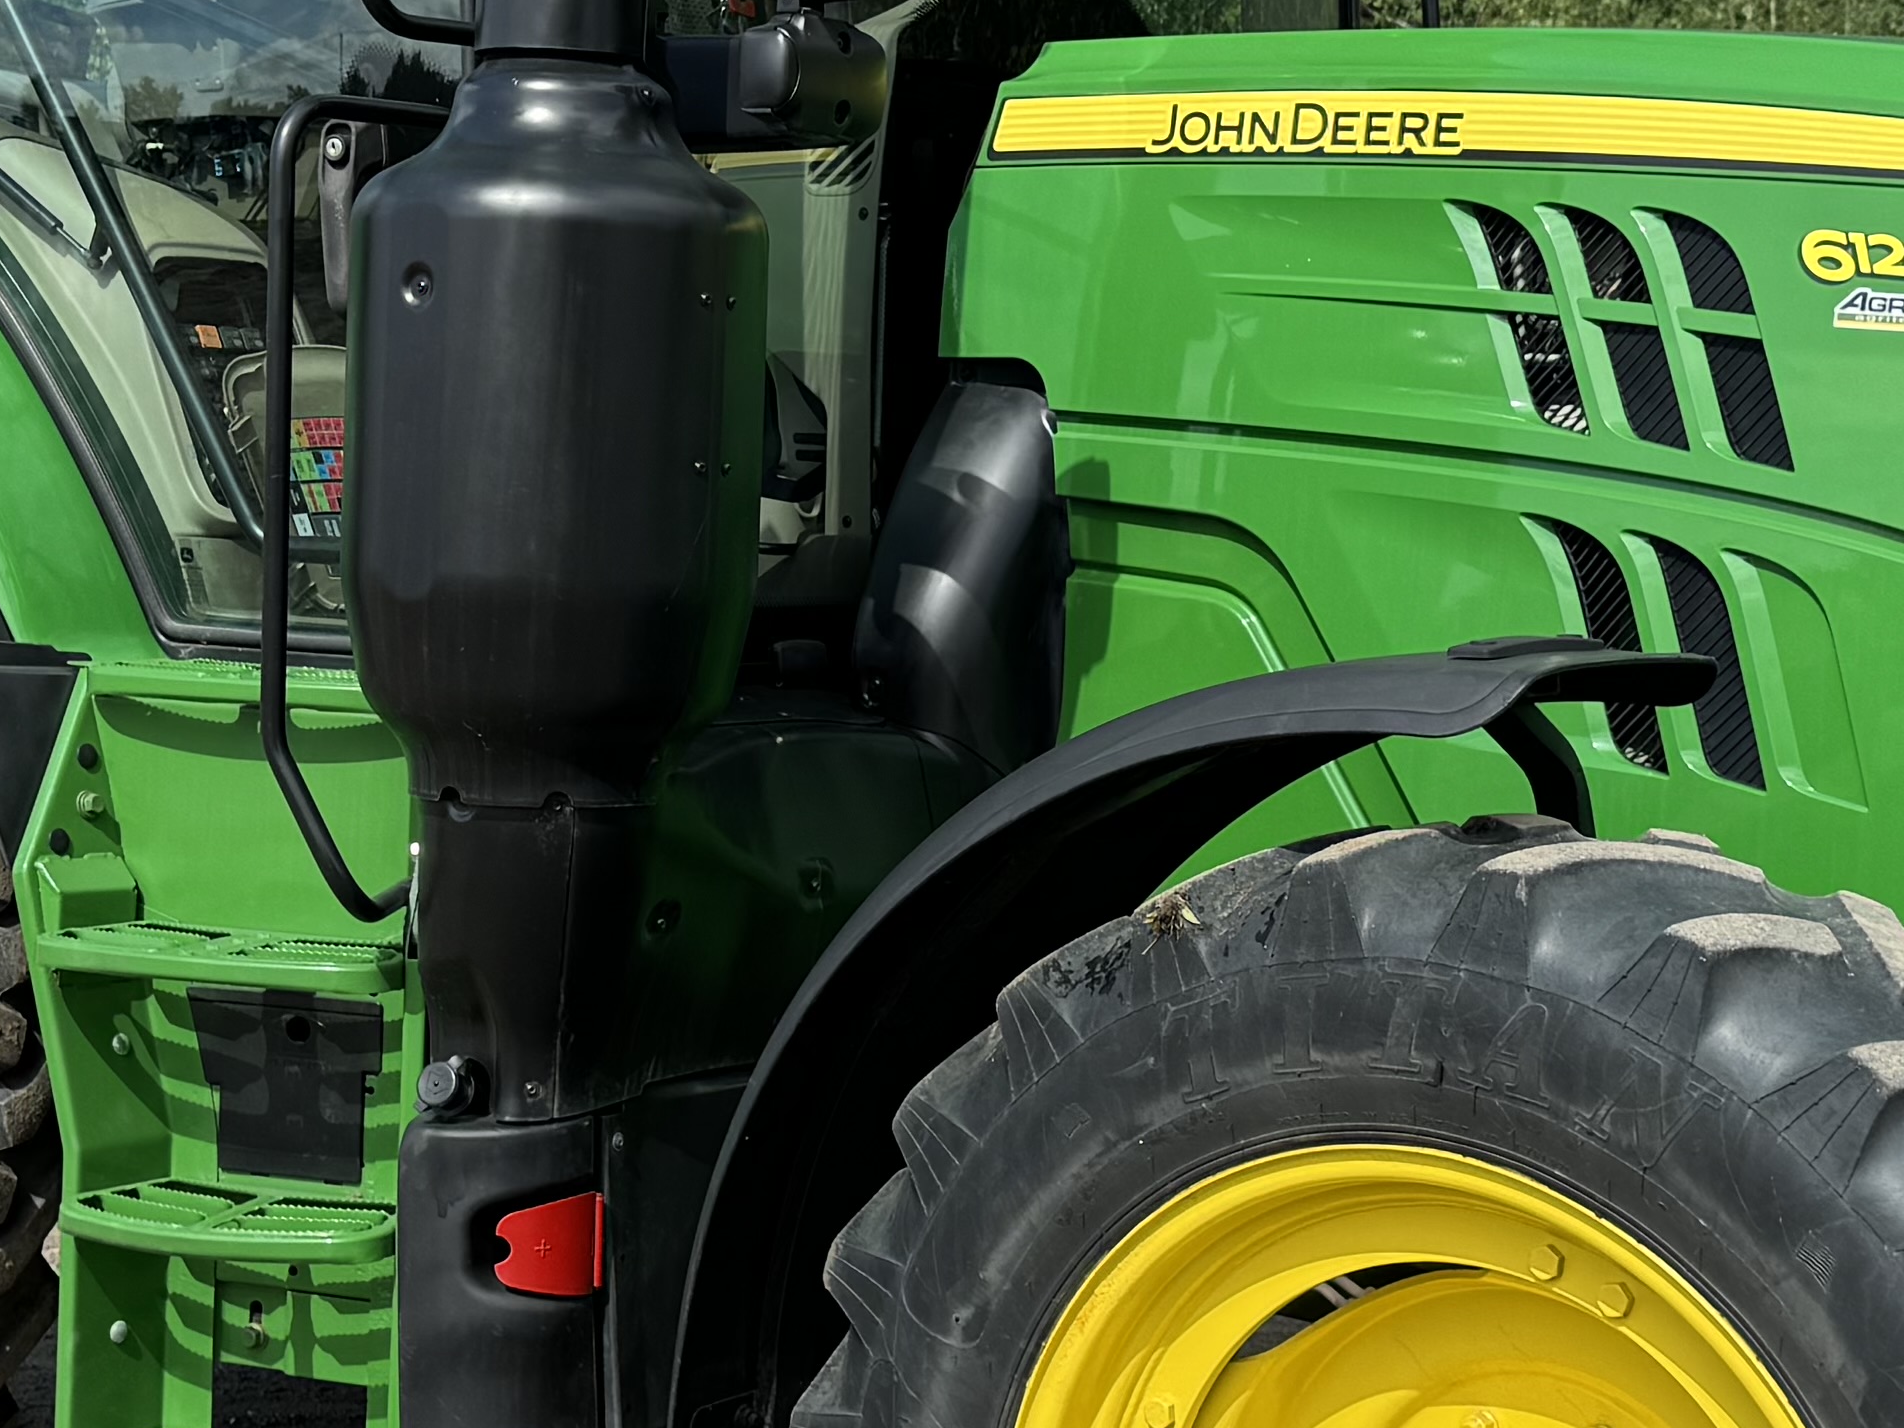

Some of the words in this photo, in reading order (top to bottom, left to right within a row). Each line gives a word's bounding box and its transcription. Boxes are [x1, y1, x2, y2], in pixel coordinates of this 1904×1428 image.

[1150, 103, 1281, 146] JOHN
[1290, 102, 1465, 148] DEERE
[1160, 958, 1726, 1170] TITAN
